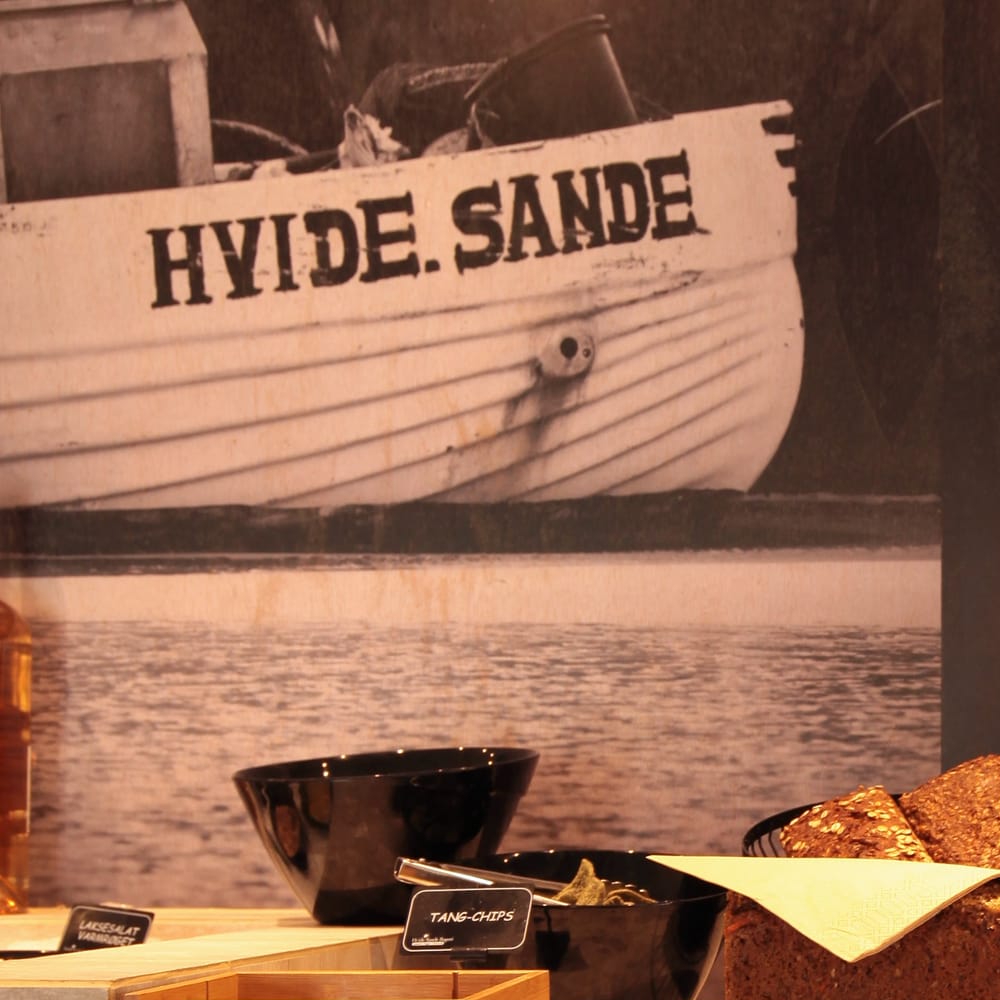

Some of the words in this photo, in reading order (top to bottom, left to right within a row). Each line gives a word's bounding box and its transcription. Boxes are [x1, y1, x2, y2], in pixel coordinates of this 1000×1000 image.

[451, 149, 700, 275] SANDE
[430, 910, 515, 923] TANG-CHIPS
[79, 920, 140, 936] LAKSESALAT
